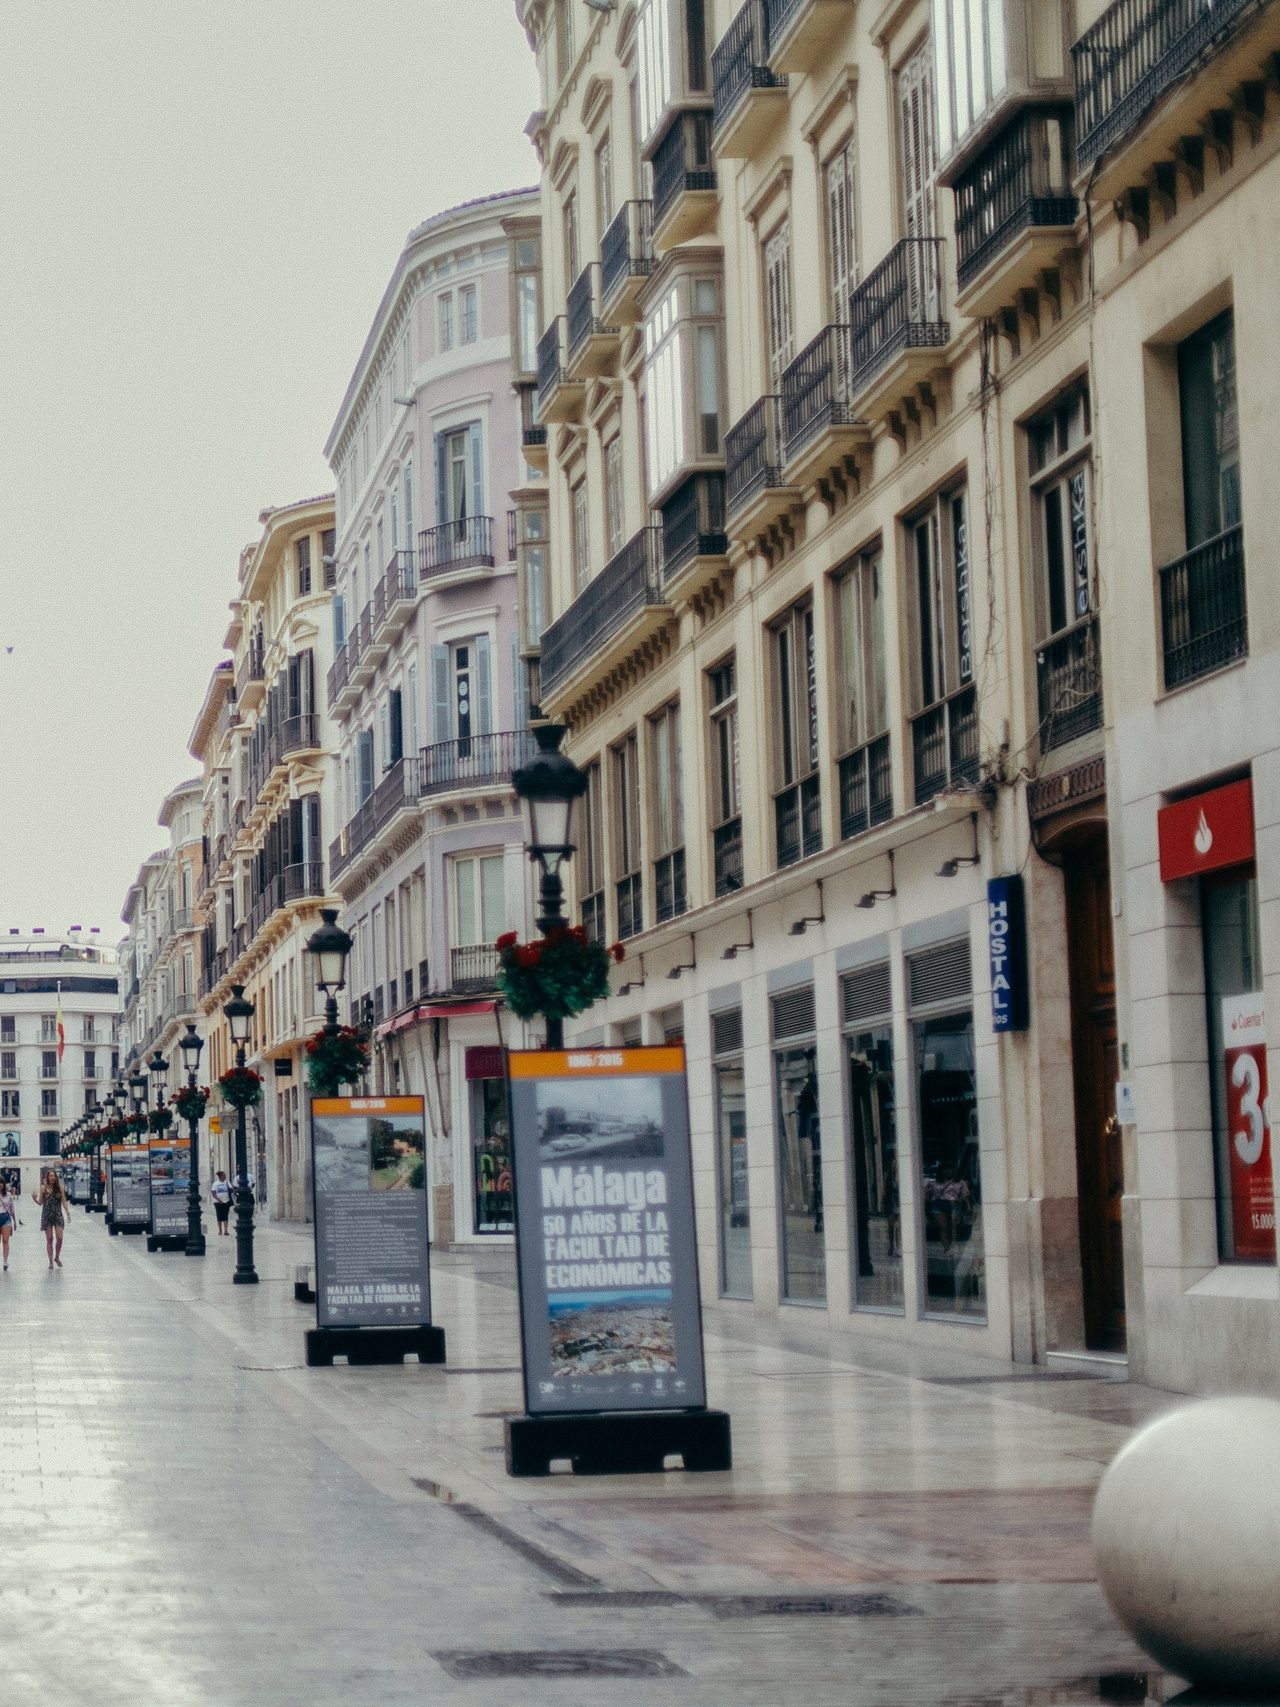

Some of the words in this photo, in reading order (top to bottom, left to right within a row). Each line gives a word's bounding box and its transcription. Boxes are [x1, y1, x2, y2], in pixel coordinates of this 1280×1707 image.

[1073, 471, 1088, 612] ershka
[958, 523, 972, 679] Bershka
[988, 901, 1010, 1010] HOSTAL
[1232, 1052, 1264, 1165] 3
[540, 1165, 668, 1211] Málaga
[542, 1214, 566, 1236] 50
[570, 1211, 617, 1235] AÑOS
[620, 1212, 642, 1233] DE
[646, 1211, 669, 1232] LA
[544, 1235, 642, 1262] FACULTAD
[646, 1233, 671, 1257] DE
[546, 1260, 672, 1289] ECONÓMICAS
